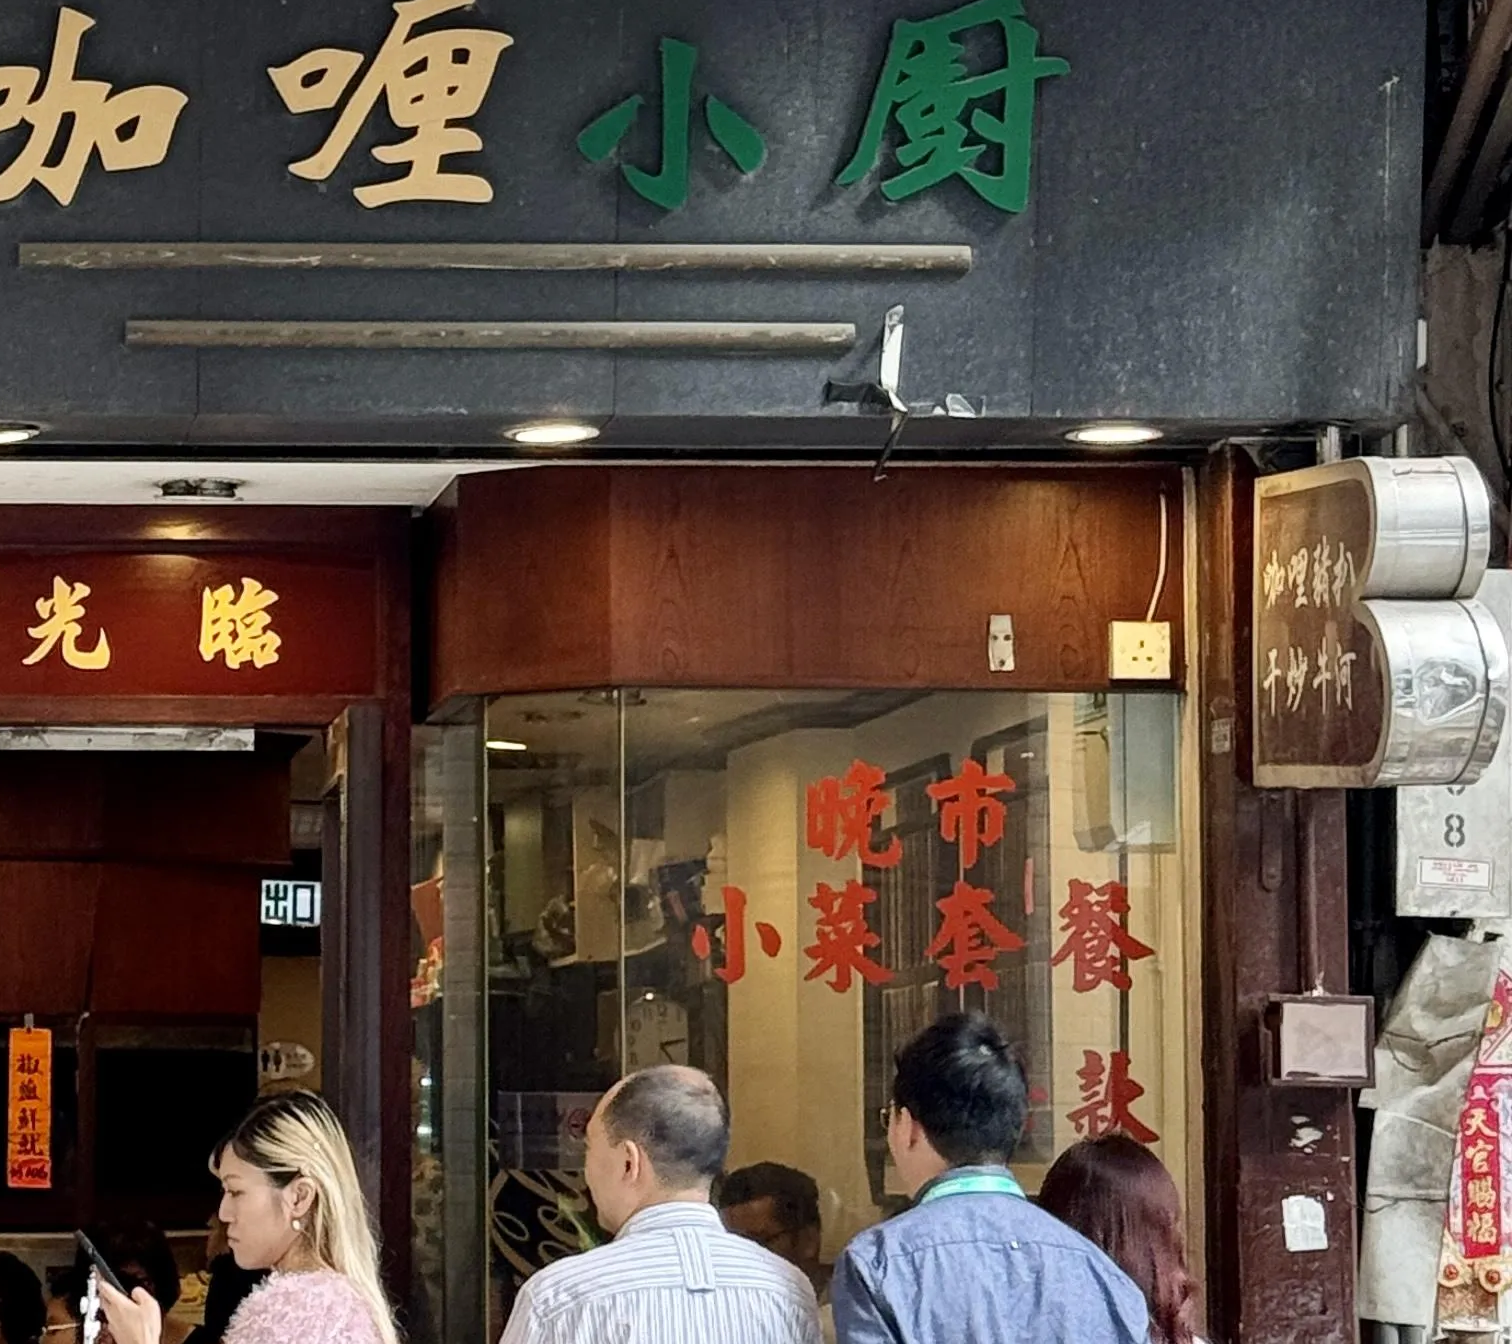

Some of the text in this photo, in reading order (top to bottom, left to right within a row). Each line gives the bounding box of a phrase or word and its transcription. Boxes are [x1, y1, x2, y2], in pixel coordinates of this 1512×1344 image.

[806, 758, 1017, 869] 晚市
[1443, 813, 1466, 848] 8
[262, 882, 316, 925] 出口
[692, 878, 1157, 993] 小菜套餐
[1464, 1107, 1499, 1245] 天官賜福
